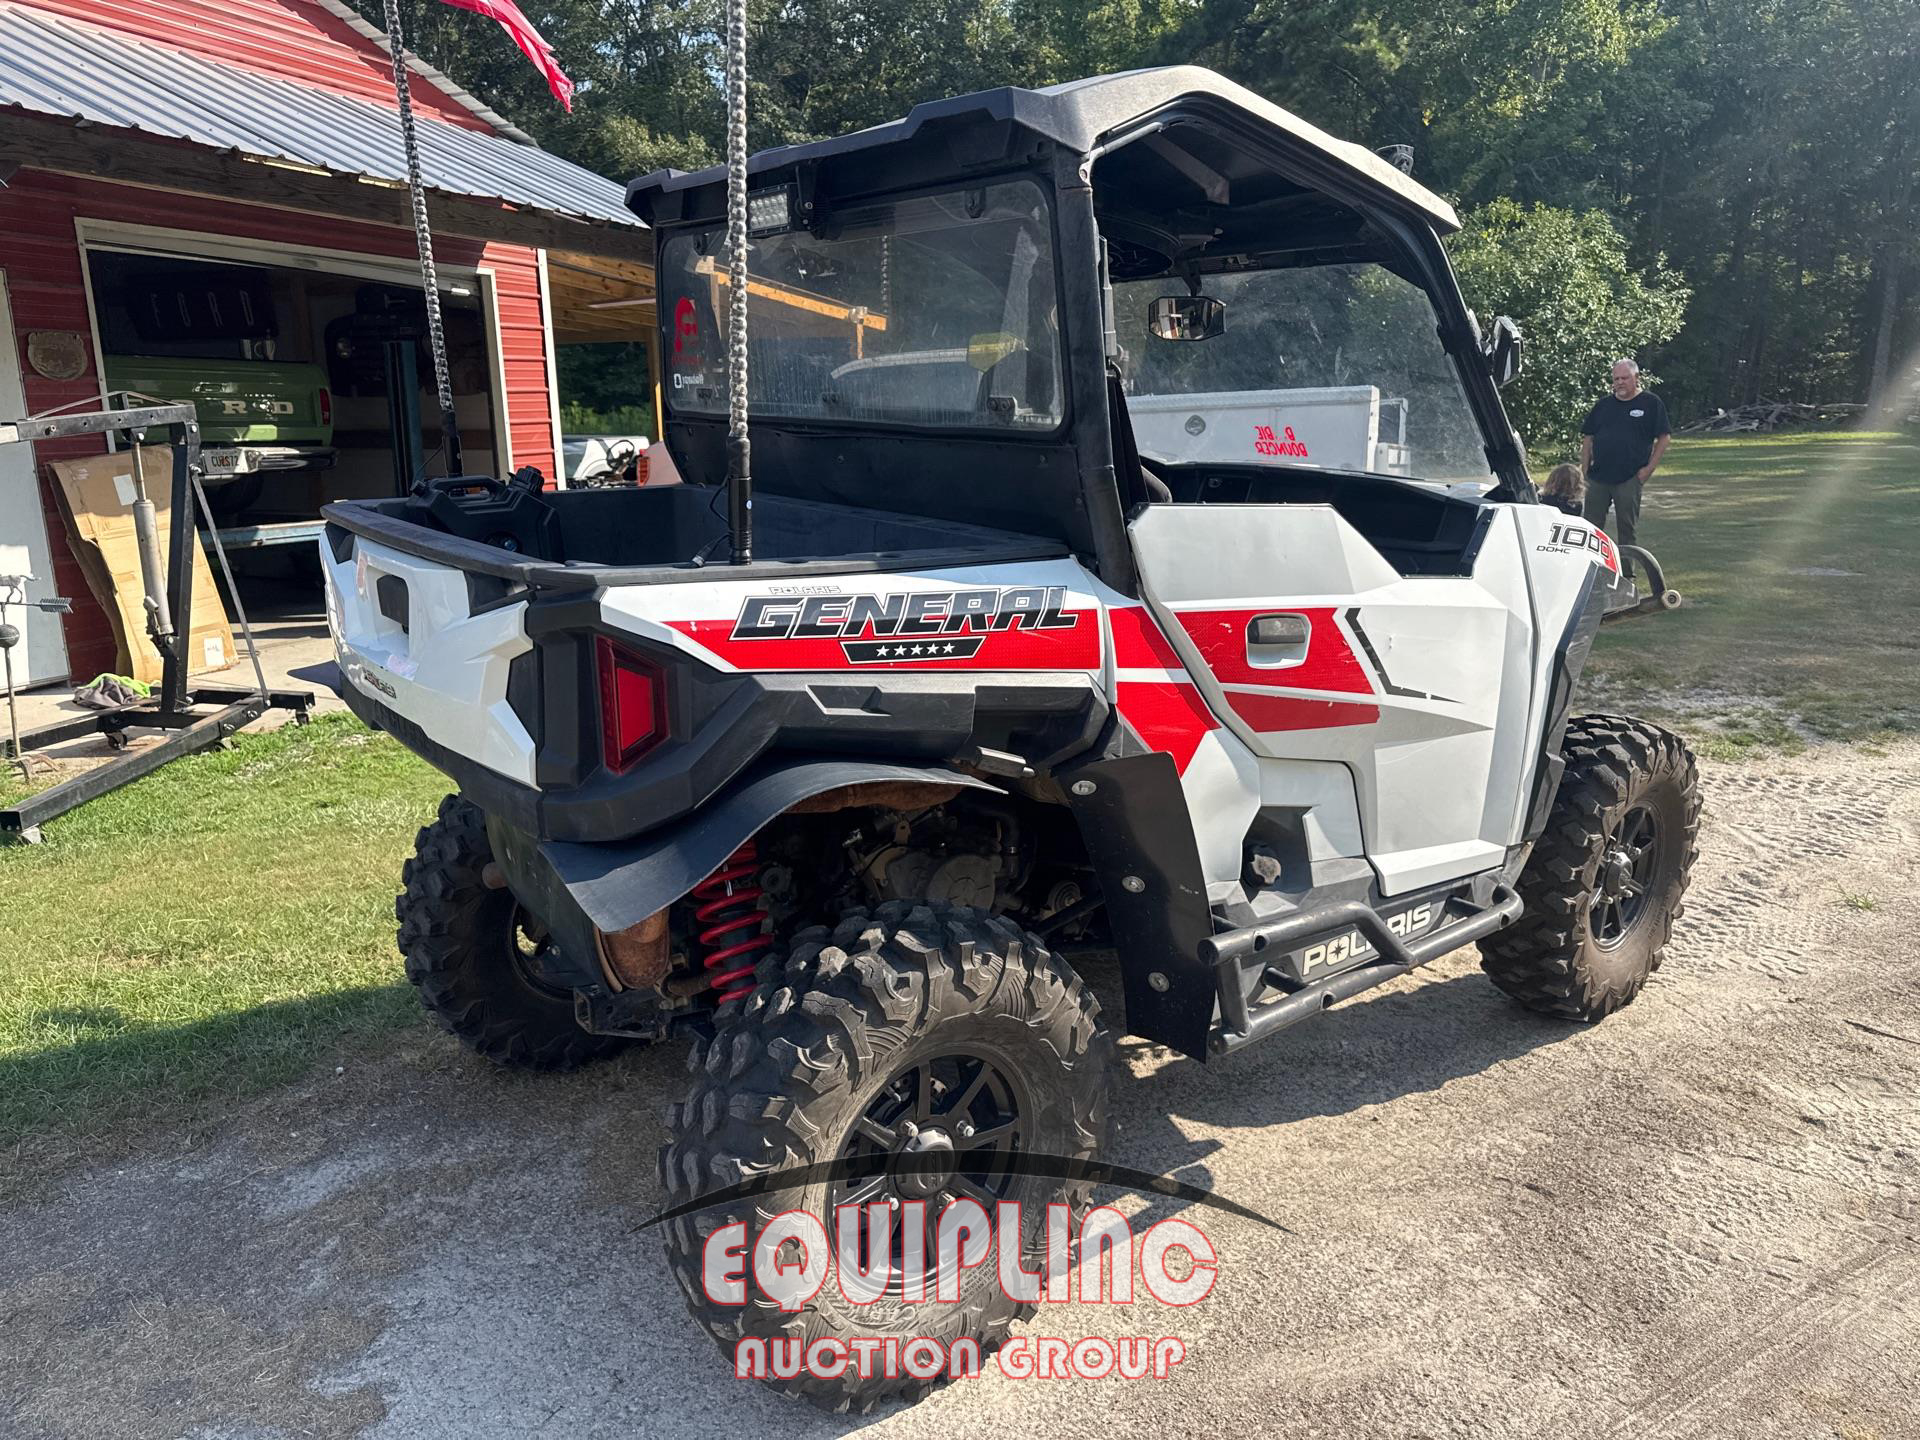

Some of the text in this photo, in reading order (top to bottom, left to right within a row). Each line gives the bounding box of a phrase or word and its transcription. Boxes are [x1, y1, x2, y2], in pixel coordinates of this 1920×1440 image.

[128, 399, 294, 414] FRD
[1536, 545, 1571, 554] DOHC
[768, 586, 842, 594] POLARIS
[728, 586, 1079, 641] GENERAL
[1302, 902, 1432, 976] POLRIS
